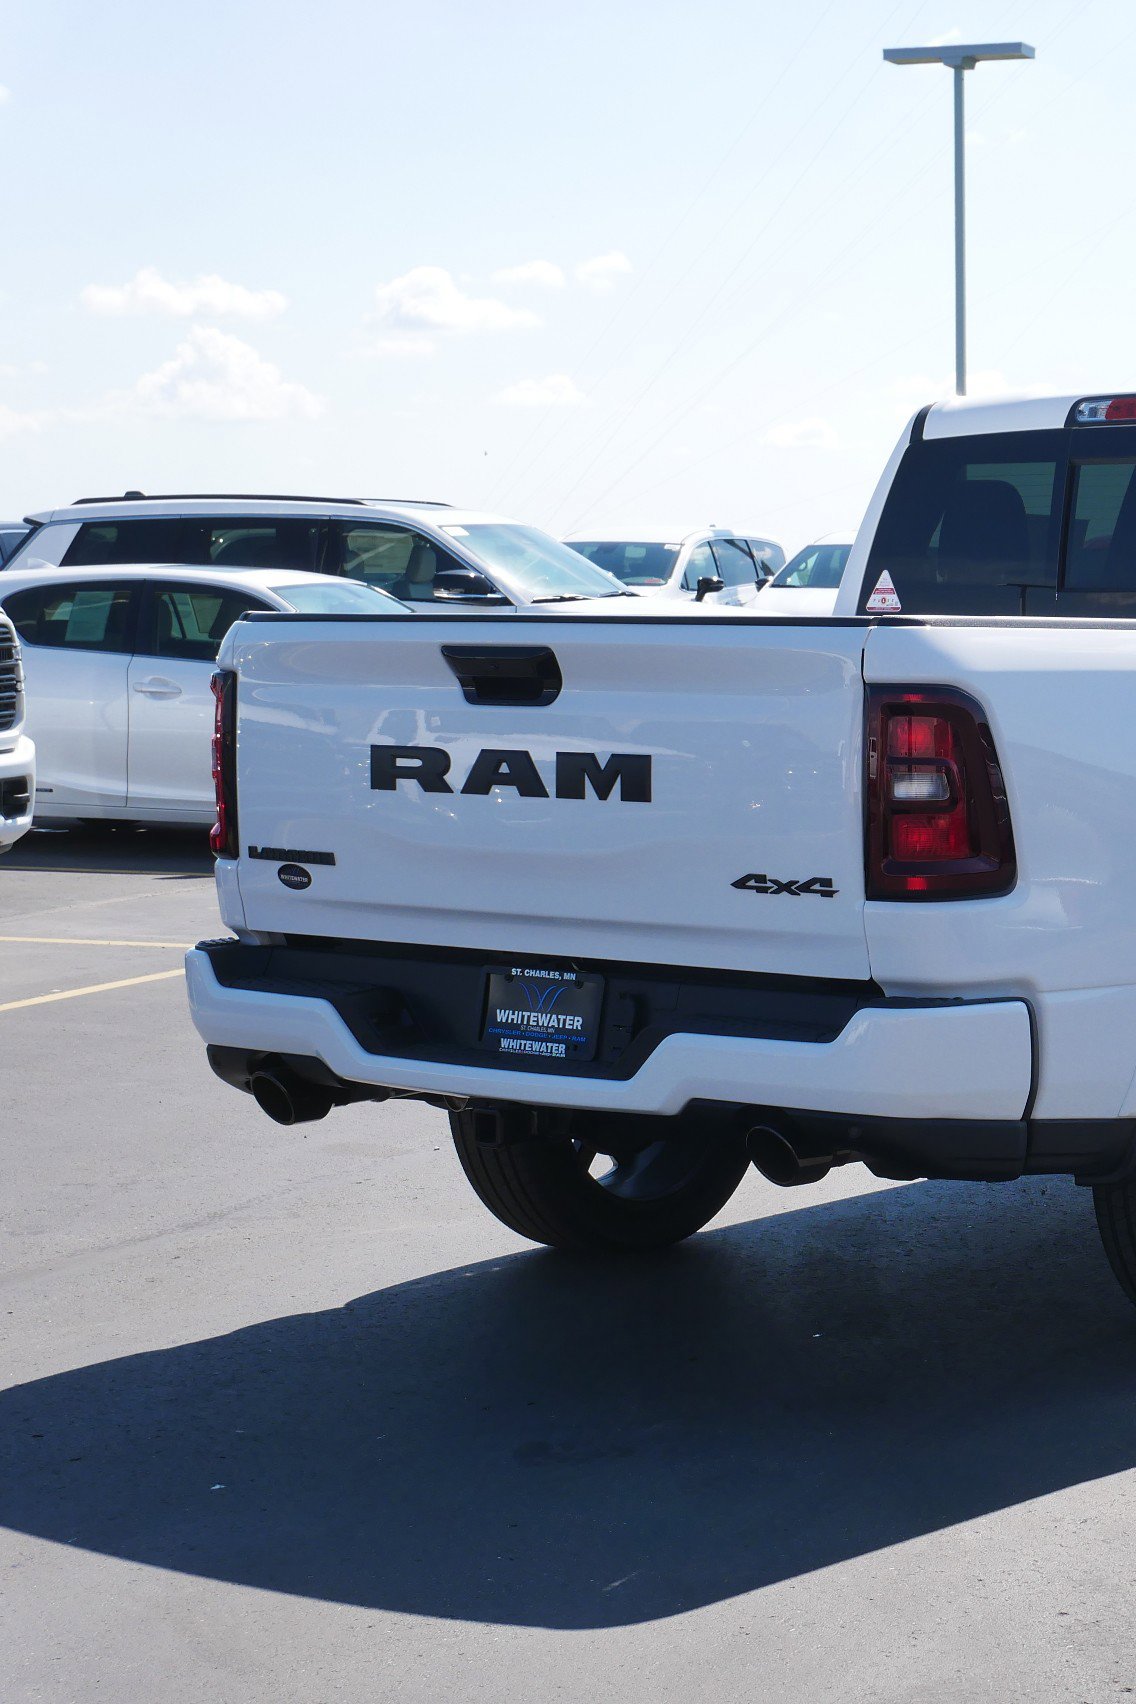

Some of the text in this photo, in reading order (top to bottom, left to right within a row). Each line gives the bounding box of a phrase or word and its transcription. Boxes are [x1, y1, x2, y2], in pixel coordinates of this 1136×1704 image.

[370, 744, 652, 802] RAM
[511, 968, 523, 976] ST.
[524, 969, 562, 980] CHARLES,
[496, 1009, 583, 1030] WHITEWATER
[500, 1037, 566, 1054] WHITEWATER
